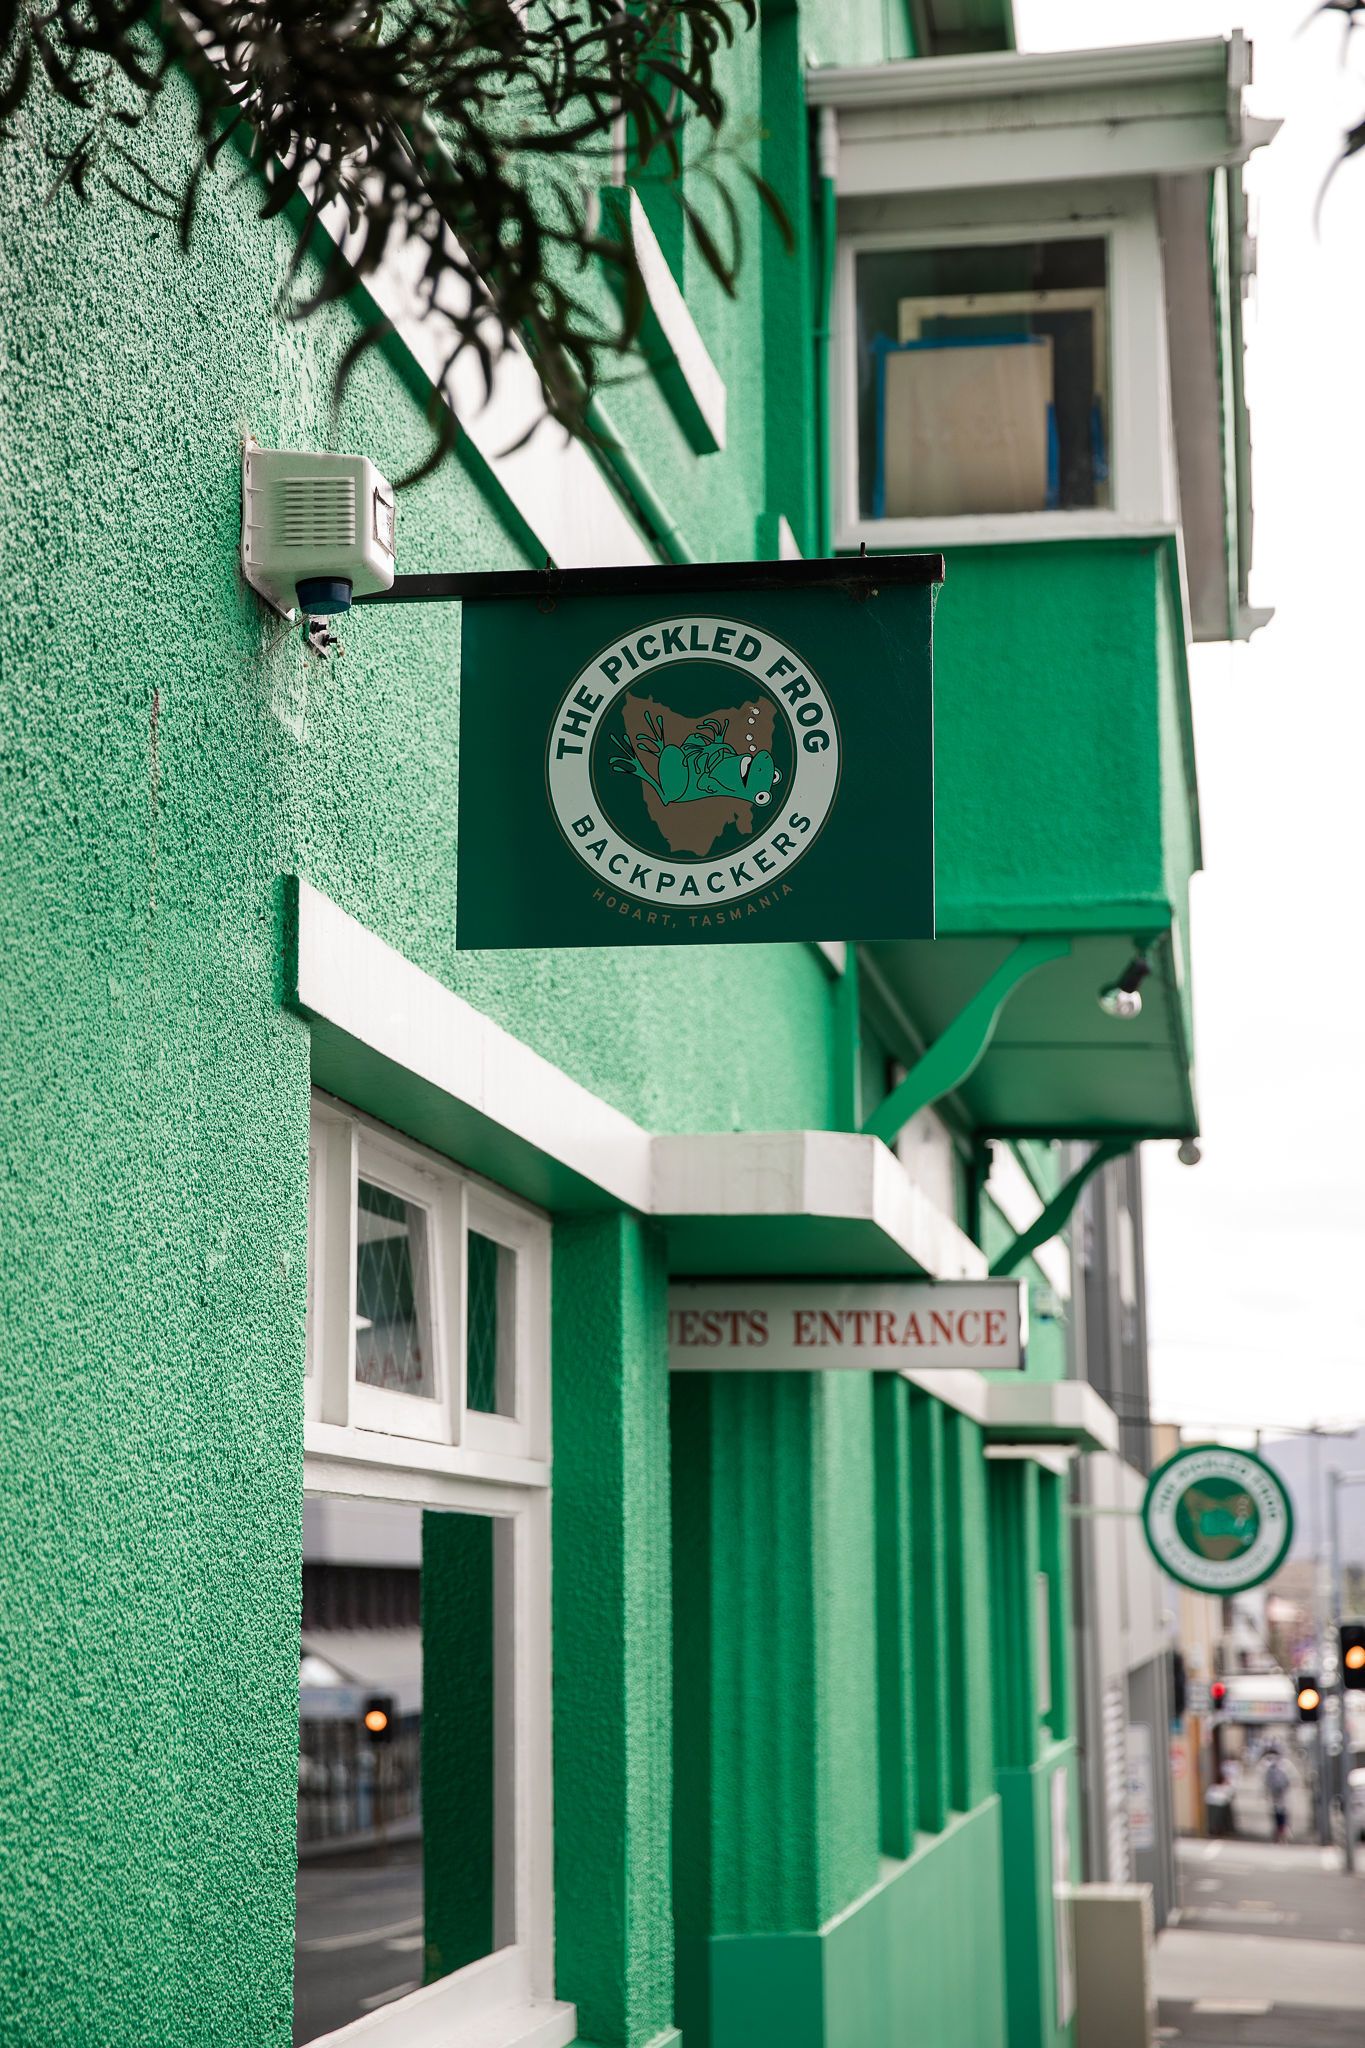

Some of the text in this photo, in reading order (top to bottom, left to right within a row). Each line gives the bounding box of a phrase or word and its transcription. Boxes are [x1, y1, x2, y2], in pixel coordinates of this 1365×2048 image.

[556, 625, 830, 760] THE PICKLED FROG
[571, 812, 811, 896] BACKPACKERS
[592, 884, 793, 928] HOBART, TASMANIA
[668, 1309, 1007, 1347] ESTS ENTRANCE
